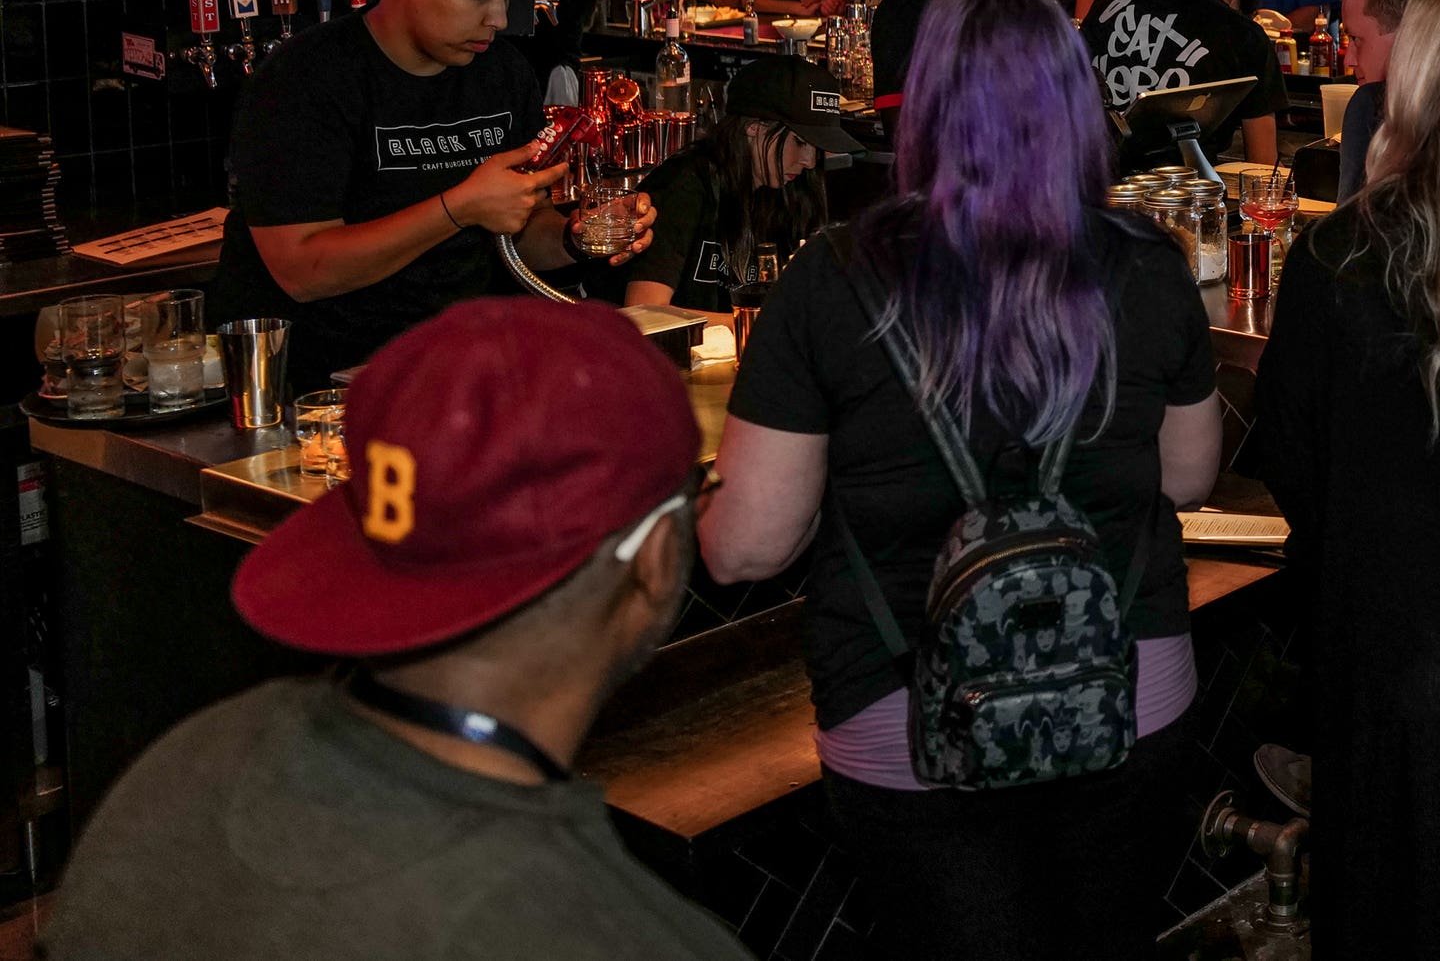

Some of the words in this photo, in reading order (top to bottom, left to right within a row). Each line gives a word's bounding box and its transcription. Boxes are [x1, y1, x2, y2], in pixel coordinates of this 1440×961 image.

[388, 135, 466, 156] BLACK
[469, 126, 505, 148] TAP
[421, 160, 443, 171] CRAFT
[362, 441, 417, 545] B
